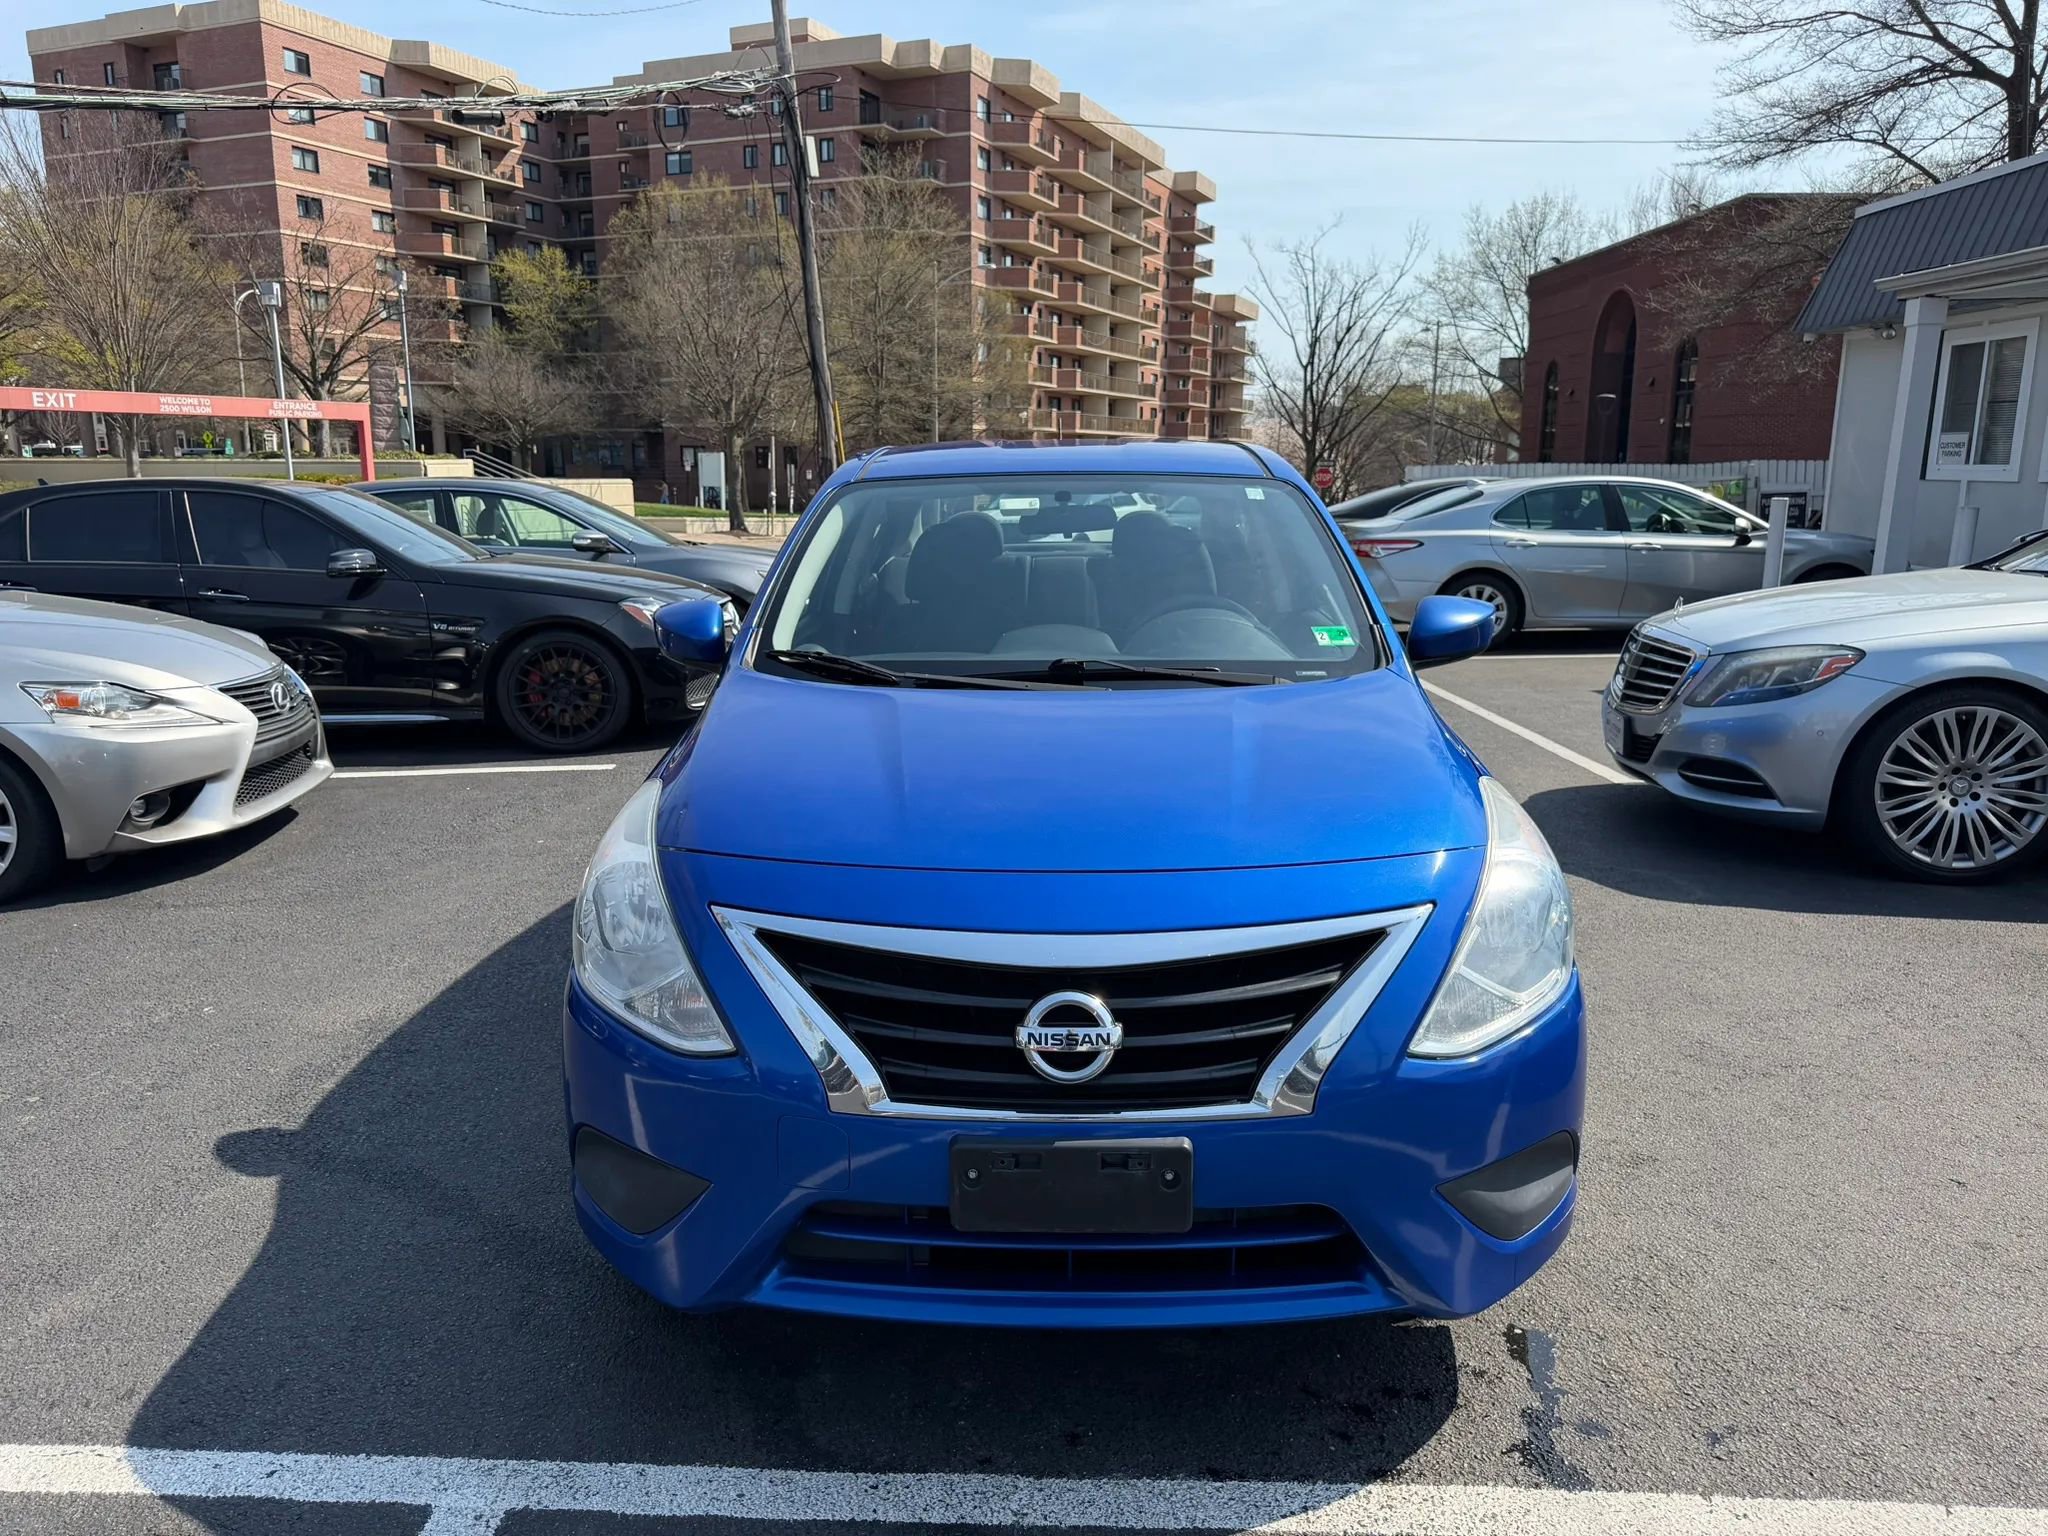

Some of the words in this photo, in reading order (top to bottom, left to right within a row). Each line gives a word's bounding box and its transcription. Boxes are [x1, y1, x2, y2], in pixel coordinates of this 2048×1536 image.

[31, 391, 77, 409] EXIT
[159, 396, 199, 405] WELCOME
[200, 398, 211, 406] TO
[159, 404, 180, 412] 2500
[181, 405, 212, 413] WILSON
[273, 401, 317, 411] ENTRANCE
[268, 409, 293, 418] PUBLIC
[1940, 441, 1966, 450] CUSTOMER
[1027, 1032, 1111, 1047] NISSAN
